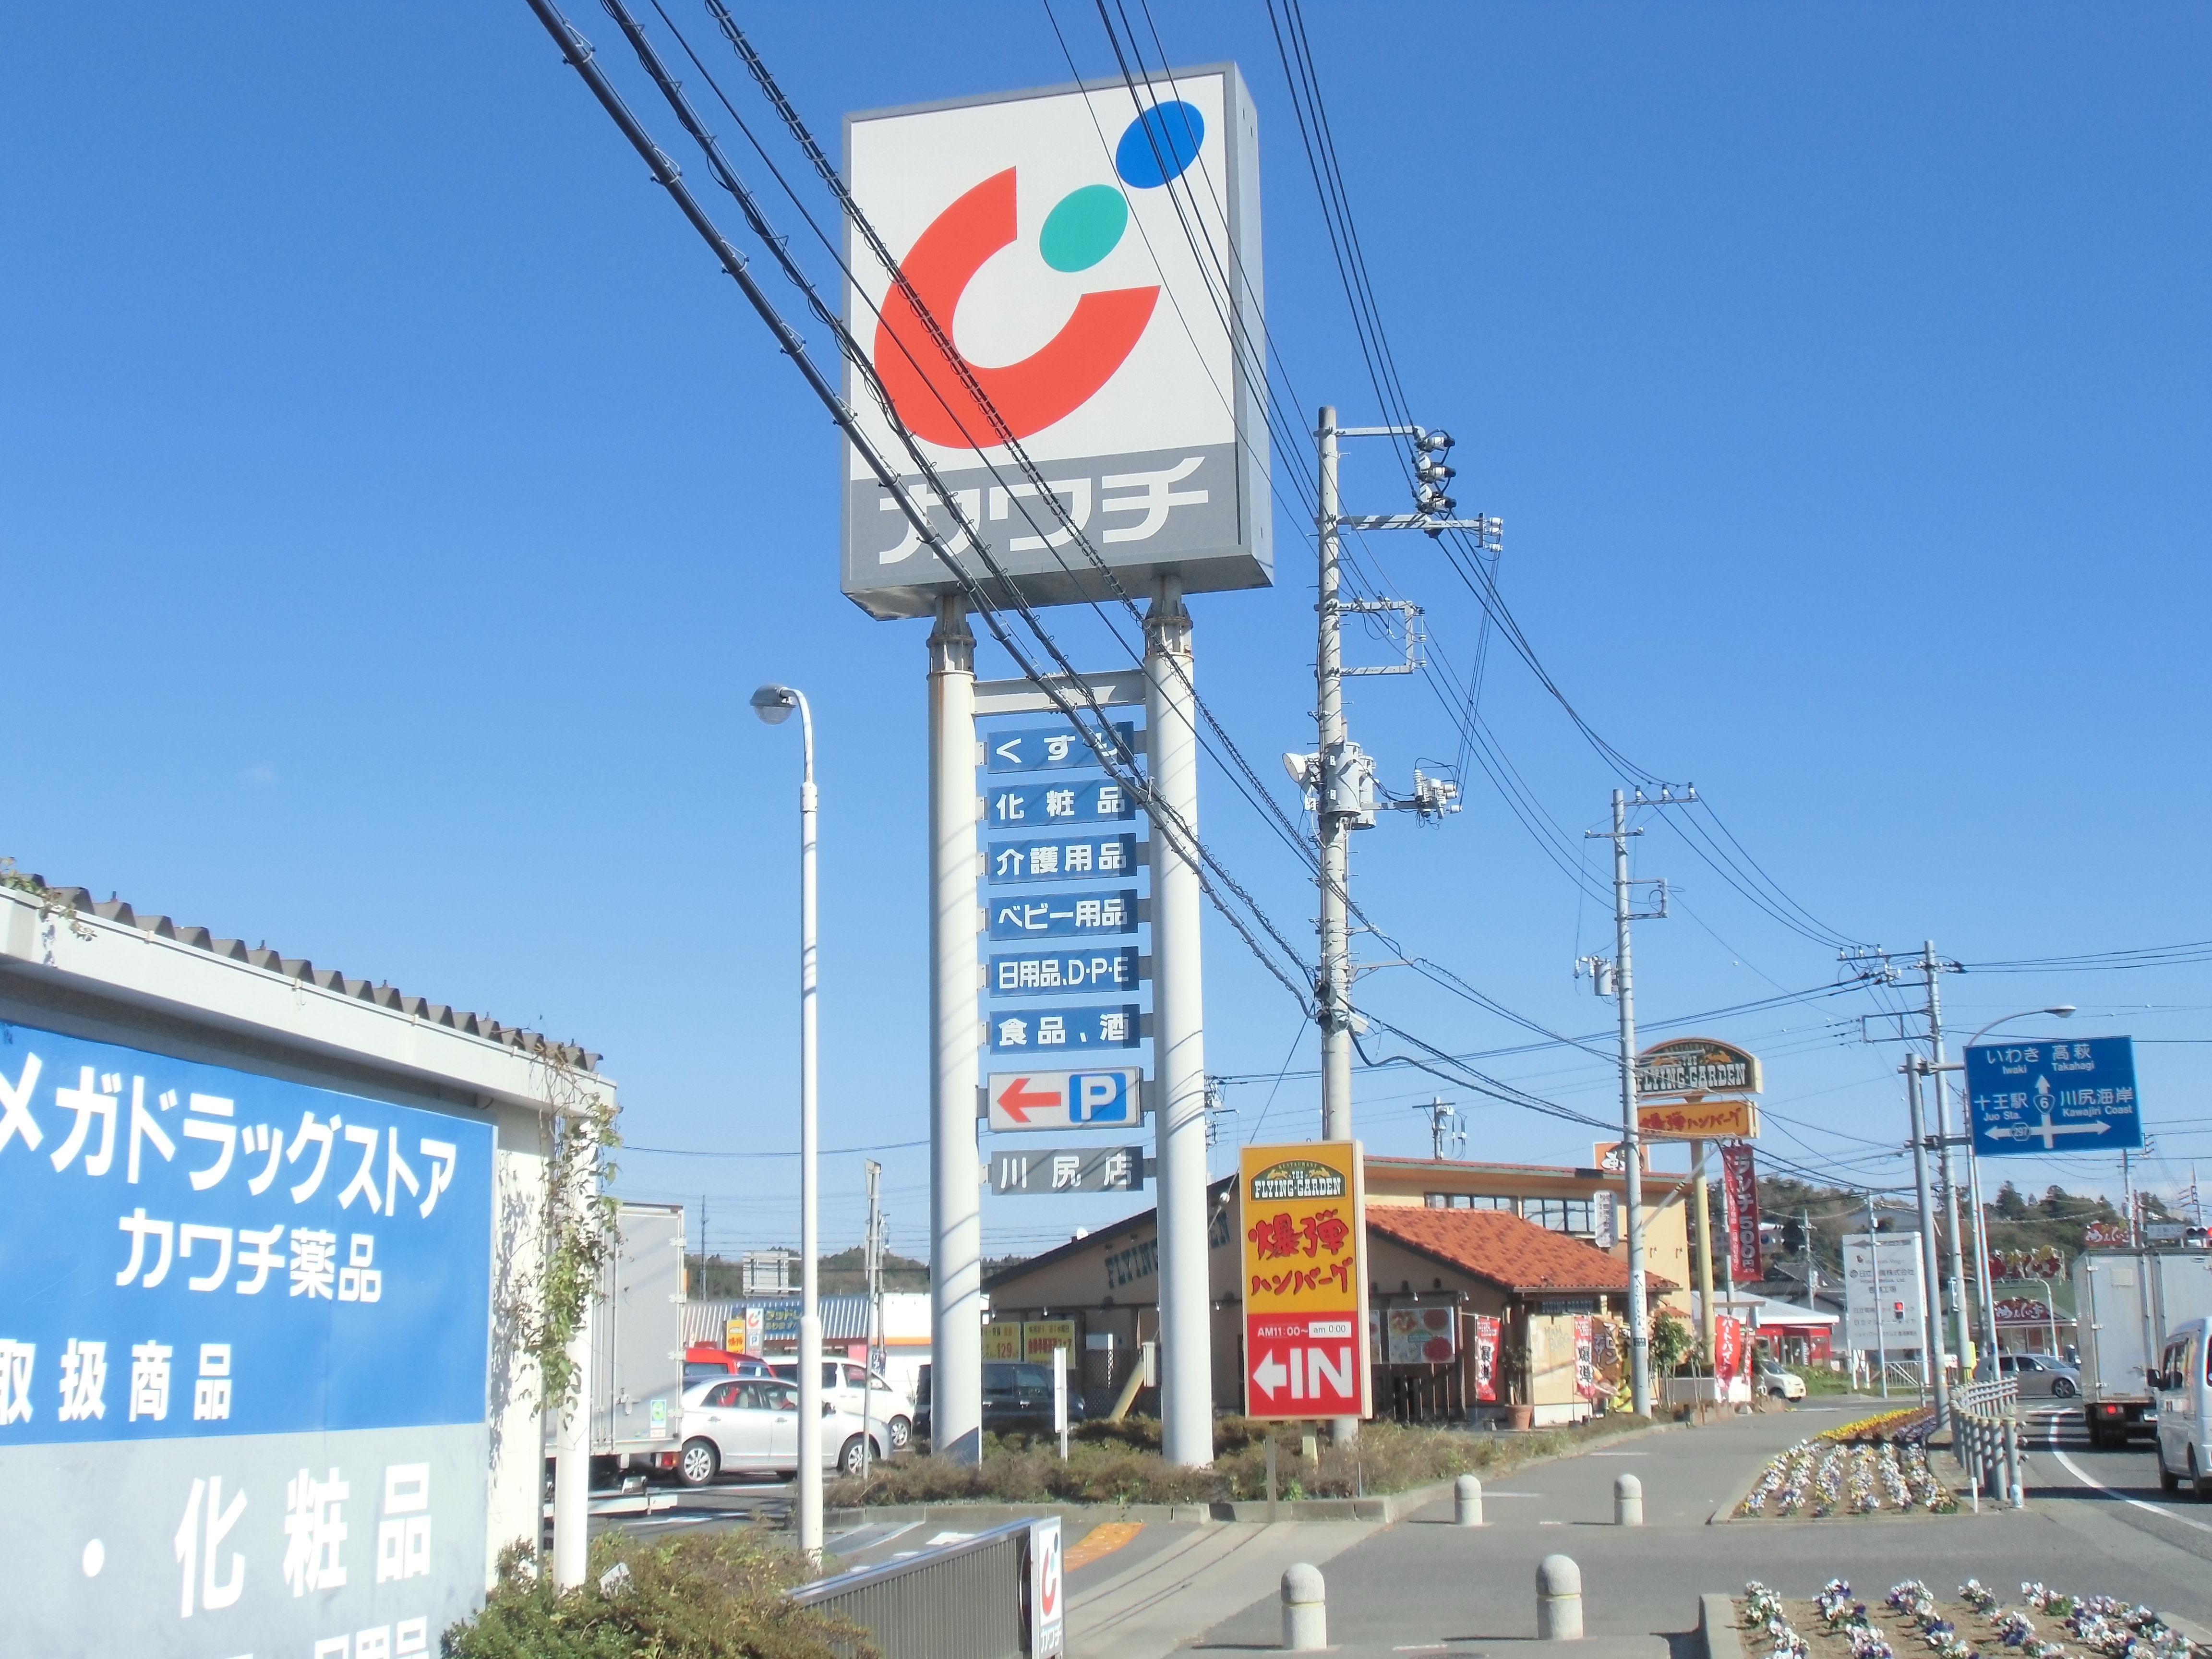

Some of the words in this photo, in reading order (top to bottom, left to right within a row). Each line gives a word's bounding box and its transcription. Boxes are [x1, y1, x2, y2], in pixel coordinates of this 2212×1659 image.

[879, 457, 1208, 565] カワチ
[996, 787, 1125, 820] 化粧品
[997, 843, 1126, 876] 介護用品
[998, 899, 1127, 930] ベビー用品
[1987, 1047, 2039, 1064] いわき
[2052, 1044, 2092, 1060] 高萩
[2002, 1065, 2027, 1074] Iwaki
[2051, 1060, 2094, 1071] Takahagi
[1081, 1076, 1117, 1120] P
[1974, 1093, 2028, 1111] 十王駅
[2040, 1098, 2049, 1109] 6
[2060, 1087, 2133, 1106] 川尻海岸
[2063, 1106, 2102, 1117] Kawajiri
[2105, 1105, 2133, 1115] Coast
[1984, 1112, 2000, 1121] Juo
[2003, 1111, 2022, 1120] Sta.
[2013, 1127, 2028, 1136] 297
[0, 1052, 457, 1219] メガドラッグストア
[1000, 1154, 1132, 1189] 川尻店
[1292, 1171, 1304, 1179] THE
[1248, 1209, 1349, 1261] 爆弾
[116, 1208, 381, 1303] カワチ薬品
[1251, 1257, 1353, 1296] ハンバーグ
[0, 1337, 232, 1425] 取扱商品
[1290, 1346, 1353, 1399] IN
[1041, 1621, 1062, 1653] カワチ
